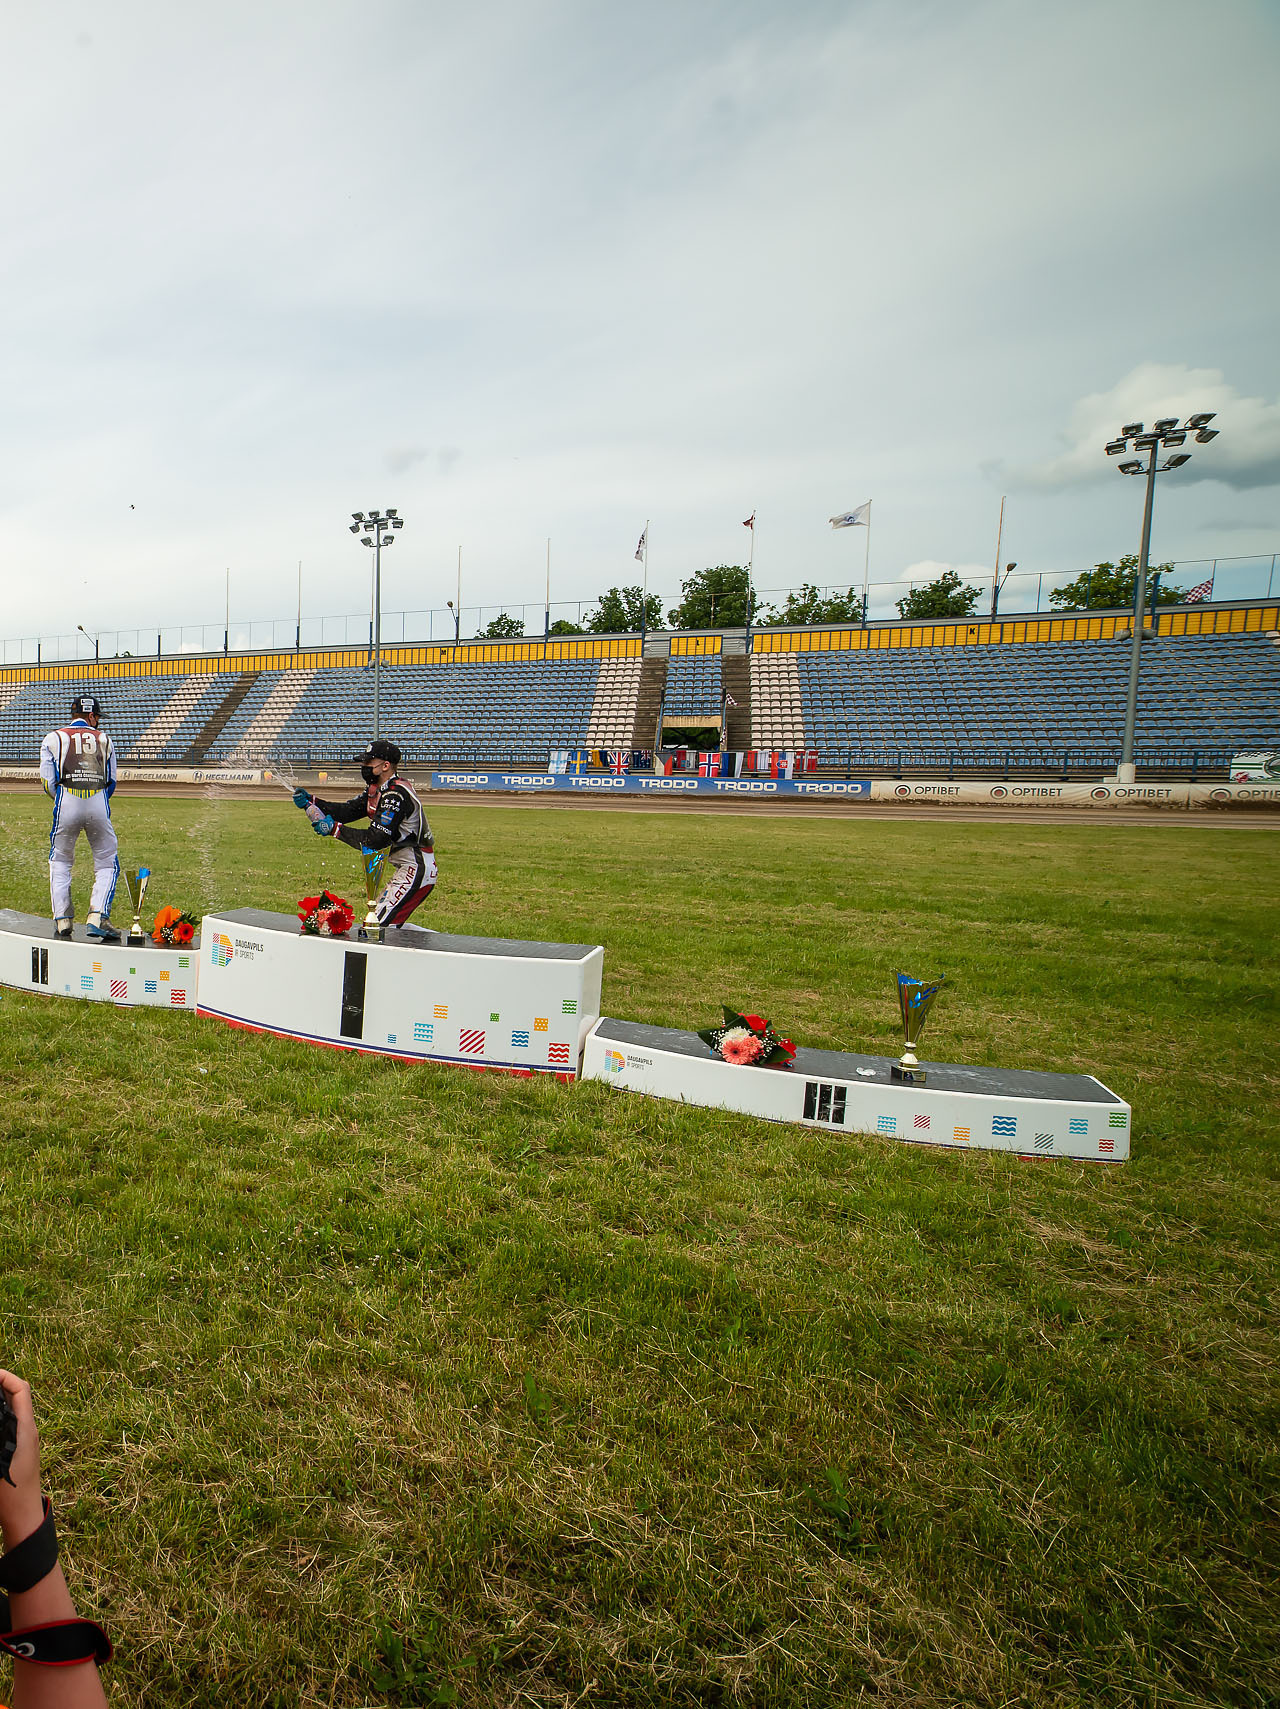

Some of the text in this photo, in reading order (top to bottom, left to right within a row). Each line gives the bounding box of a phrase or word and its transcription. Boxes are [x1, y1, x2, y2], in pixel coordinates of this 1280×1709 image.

[71, 732, 97, 754] 13
[438, 775, 489, 784] TRODO
[502, 776, 555, 785] TRODO
[569, 777, 625, 787] TRODO
[638, 778, 698, 789] TRODO
[714, 780, 777, 791] TRODO
[794, 782, 862, 793] TRODO
[914, 786, 960, 795] OPTIBET
[1011, 787, 1063, 796] OPTIBET
[1114, 788, 1172, 798] OPTIBET
[389, 866, 416, 906] LATVIA
[235, 939, 263, 952] DAUGAVPILS
